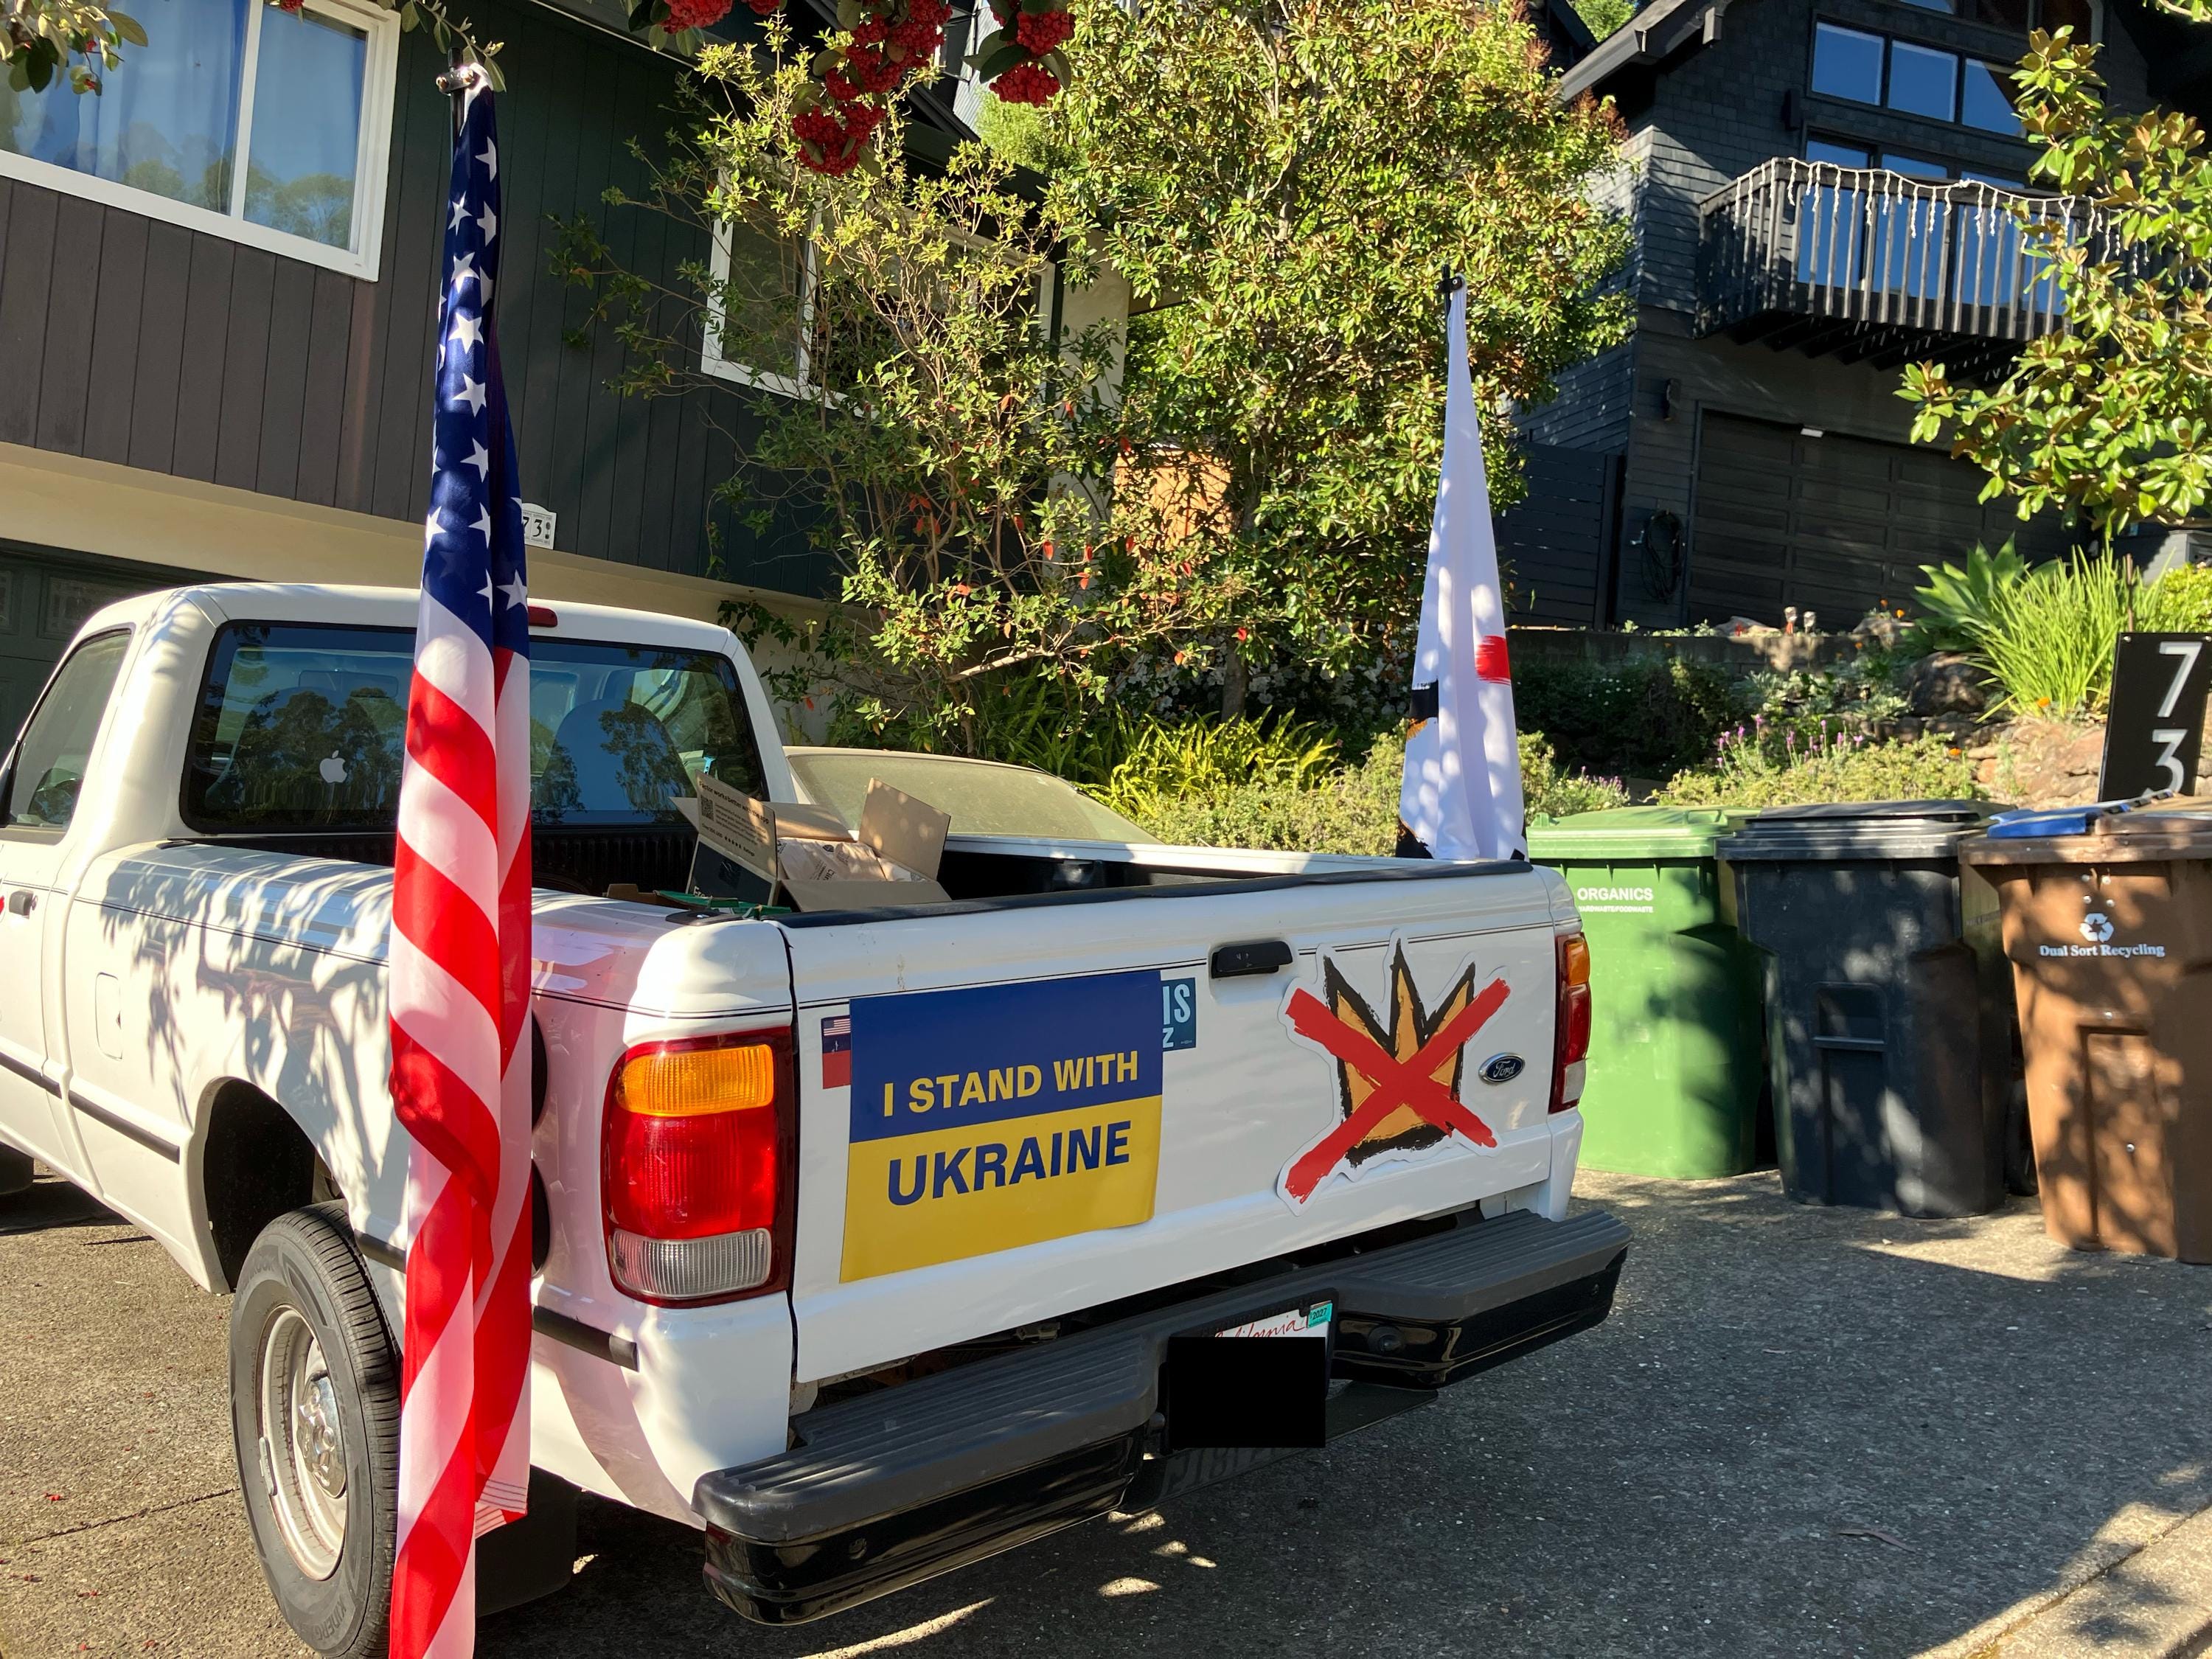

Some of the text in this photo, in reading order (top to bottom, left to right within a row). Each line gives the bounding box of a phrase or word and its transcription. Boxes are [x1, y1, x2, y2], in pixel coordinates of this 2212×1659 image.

[1577, 887, 1654, 901] ORGANICS
[2039, 944, 2166, 958] Dual Sort Recycling
[1493, 1060, 1517, 1078] Ford
[884, 1050, 1138, 1116] I STAND WITH
[888, 1120, 1131, 1206] UKRAINE
